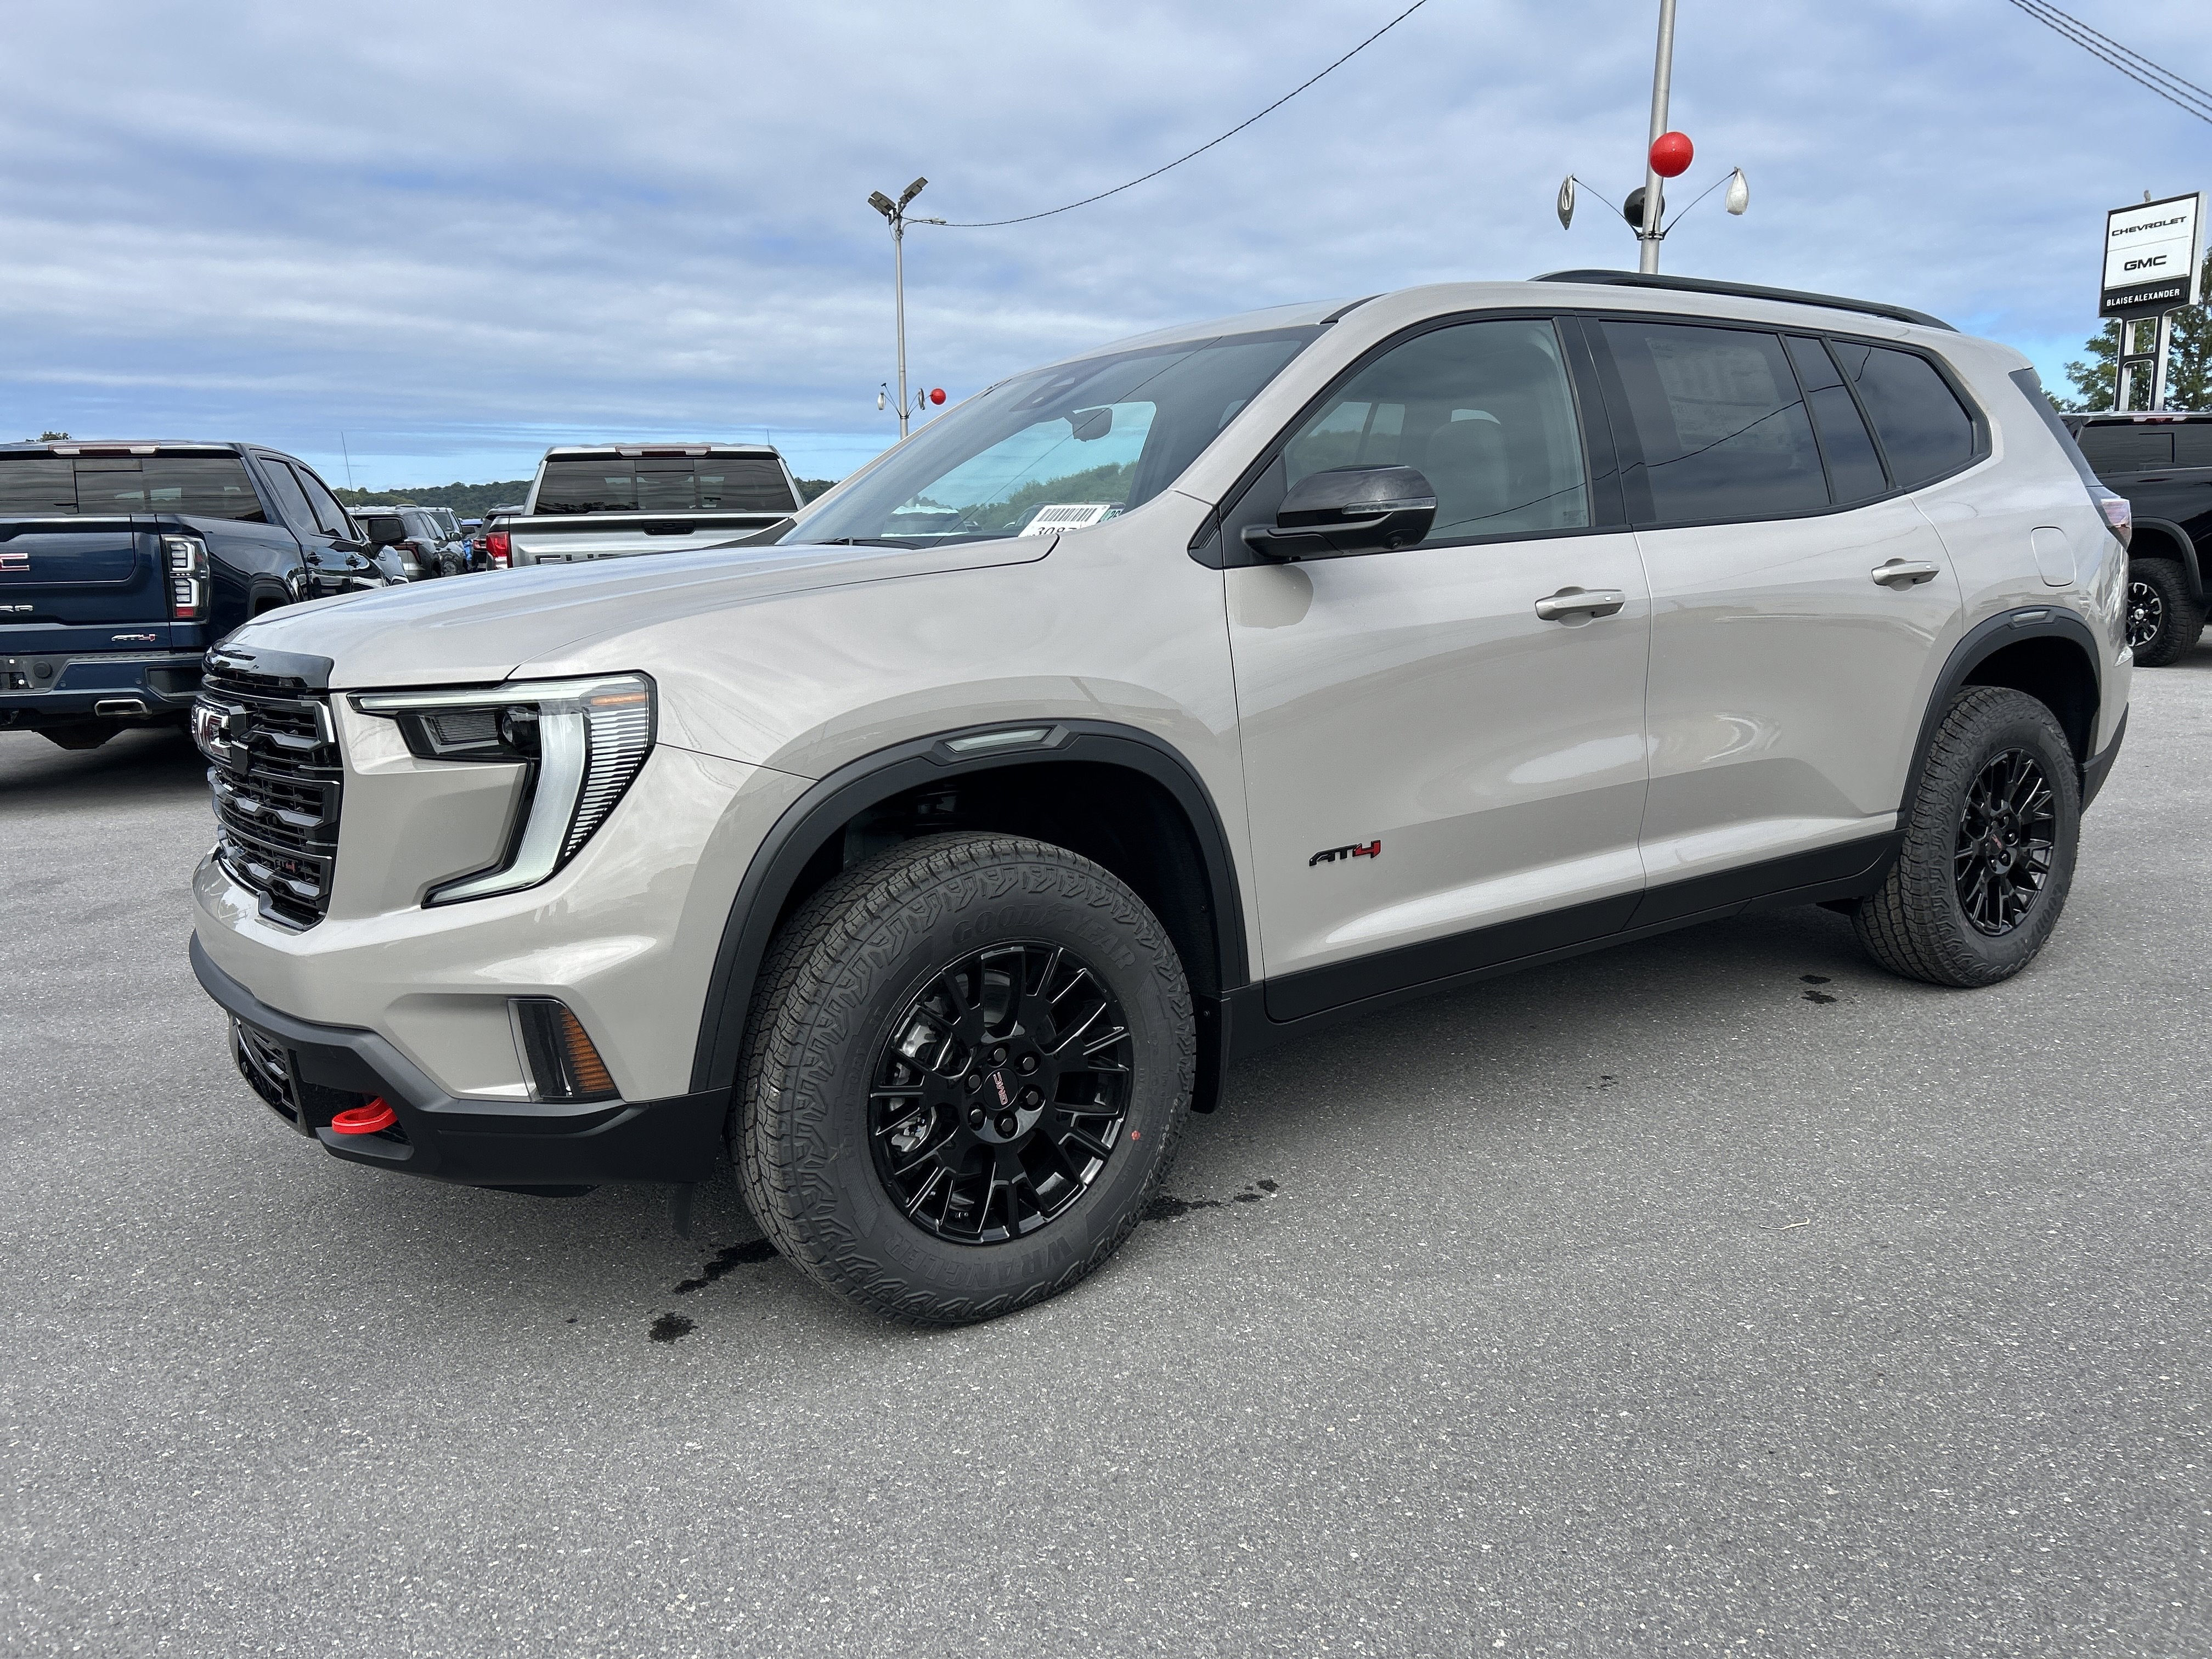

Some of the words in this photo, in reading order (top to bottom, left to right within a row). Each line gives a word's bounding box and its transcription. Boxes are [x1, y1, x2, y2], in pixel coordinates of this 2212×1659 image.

[2112, 216, 2187, 236] CHEVROLET
[2124, 255, 2167, 271] GMC
[2106, 295, 2134, 307] BLAISE
[2134, 288, 2180, 302] ALEXANDER
[1309, 839, 1381, 867] AT4
[951, 902, 1137, 970] GOODYEAR
[992, 1071, 1008, 1106] GMC
[883, 1232, 1074, 1288] WRANGLER
